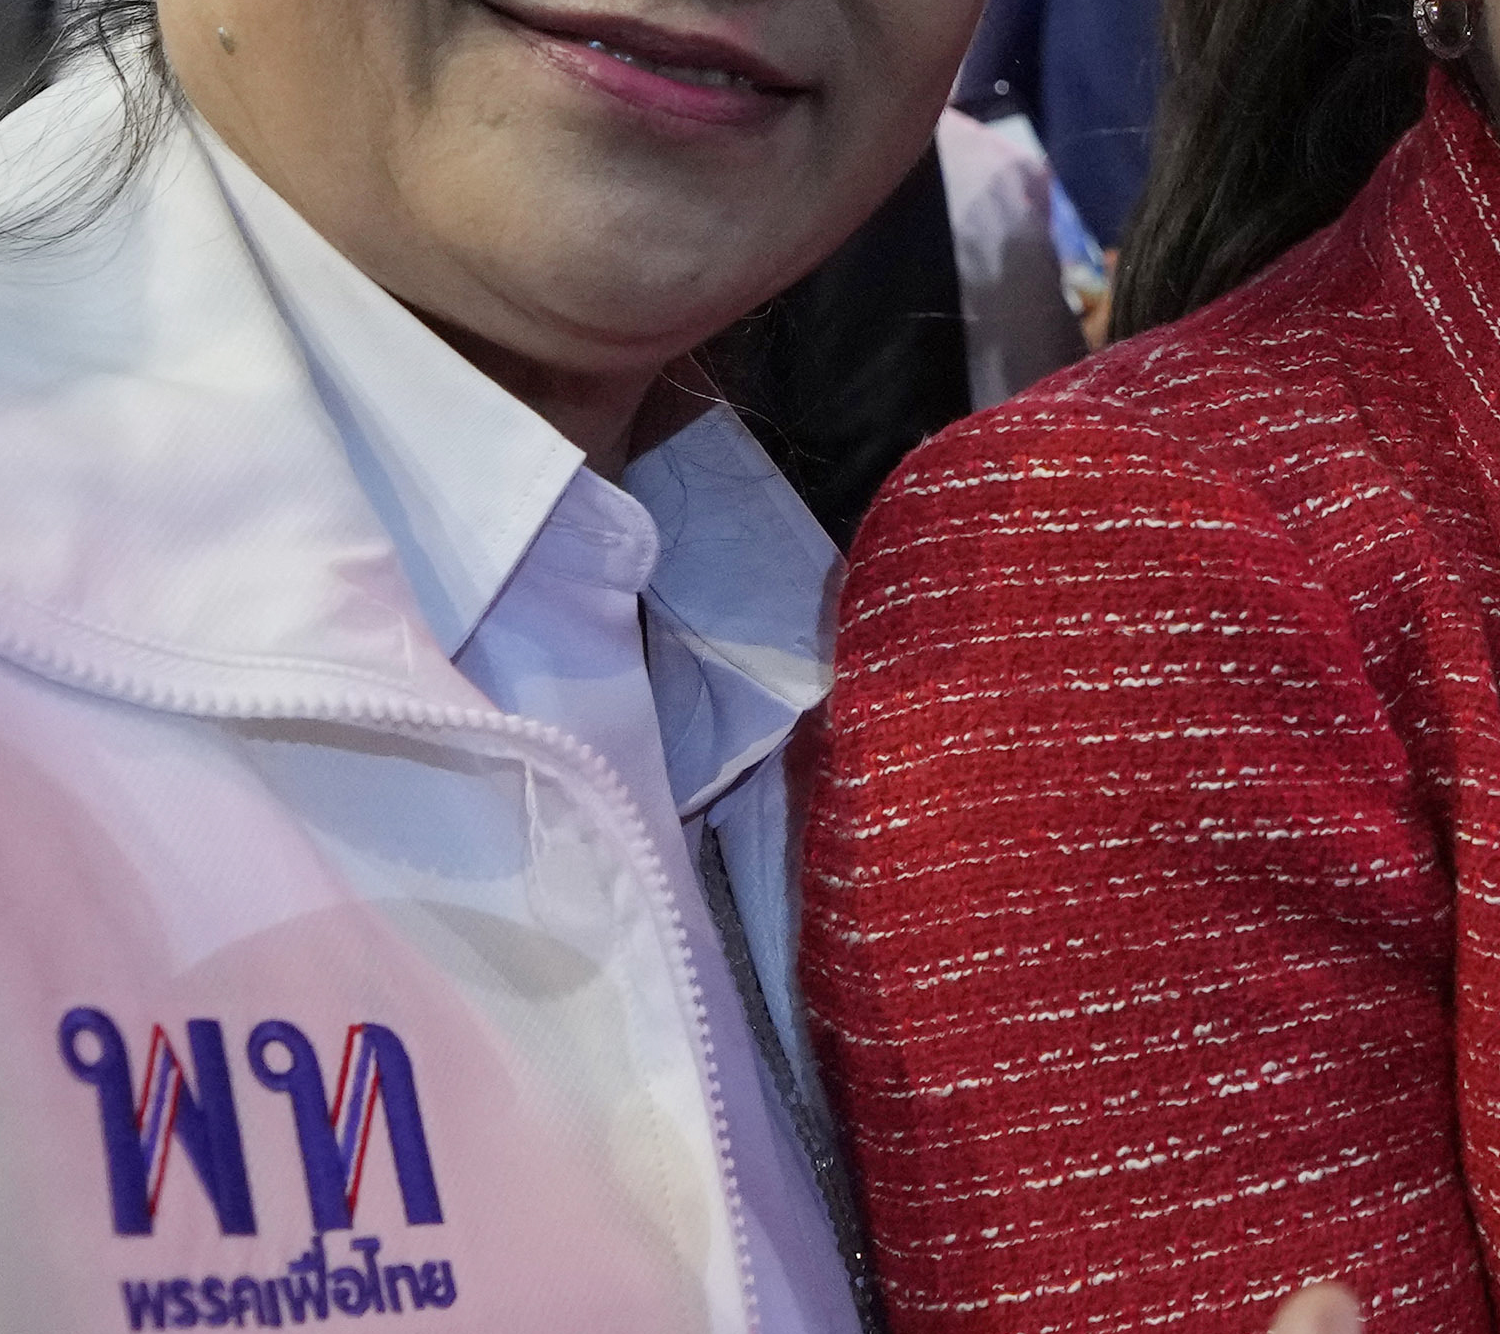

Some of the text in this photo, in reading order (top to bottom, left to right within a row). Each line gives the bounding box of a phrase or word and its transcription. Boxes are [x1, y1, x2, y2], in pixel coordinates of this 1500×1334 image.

[57, 1005, 445, 1238] พท
[121, 1234, 459, 1334] พรรคเพื่อไทย
